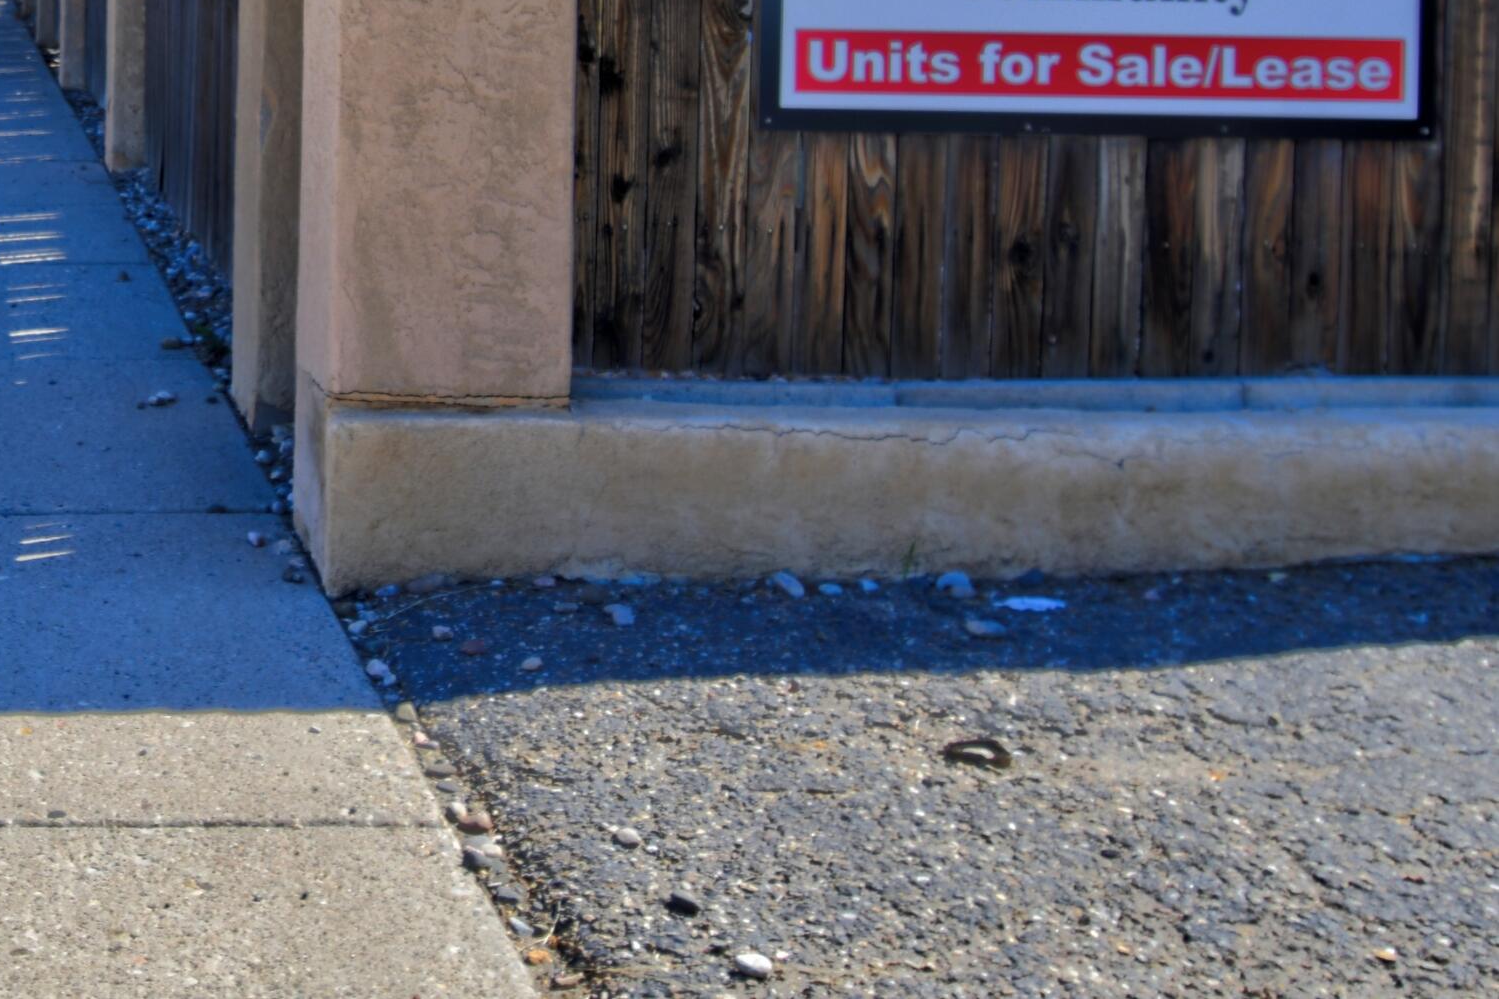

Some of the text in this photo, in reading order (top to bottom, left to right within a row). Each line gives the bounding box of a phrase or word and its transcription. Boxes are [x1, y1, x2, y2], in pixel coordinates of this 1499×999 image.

[807, 39, 1392, 90] Units for Sale/Lease
